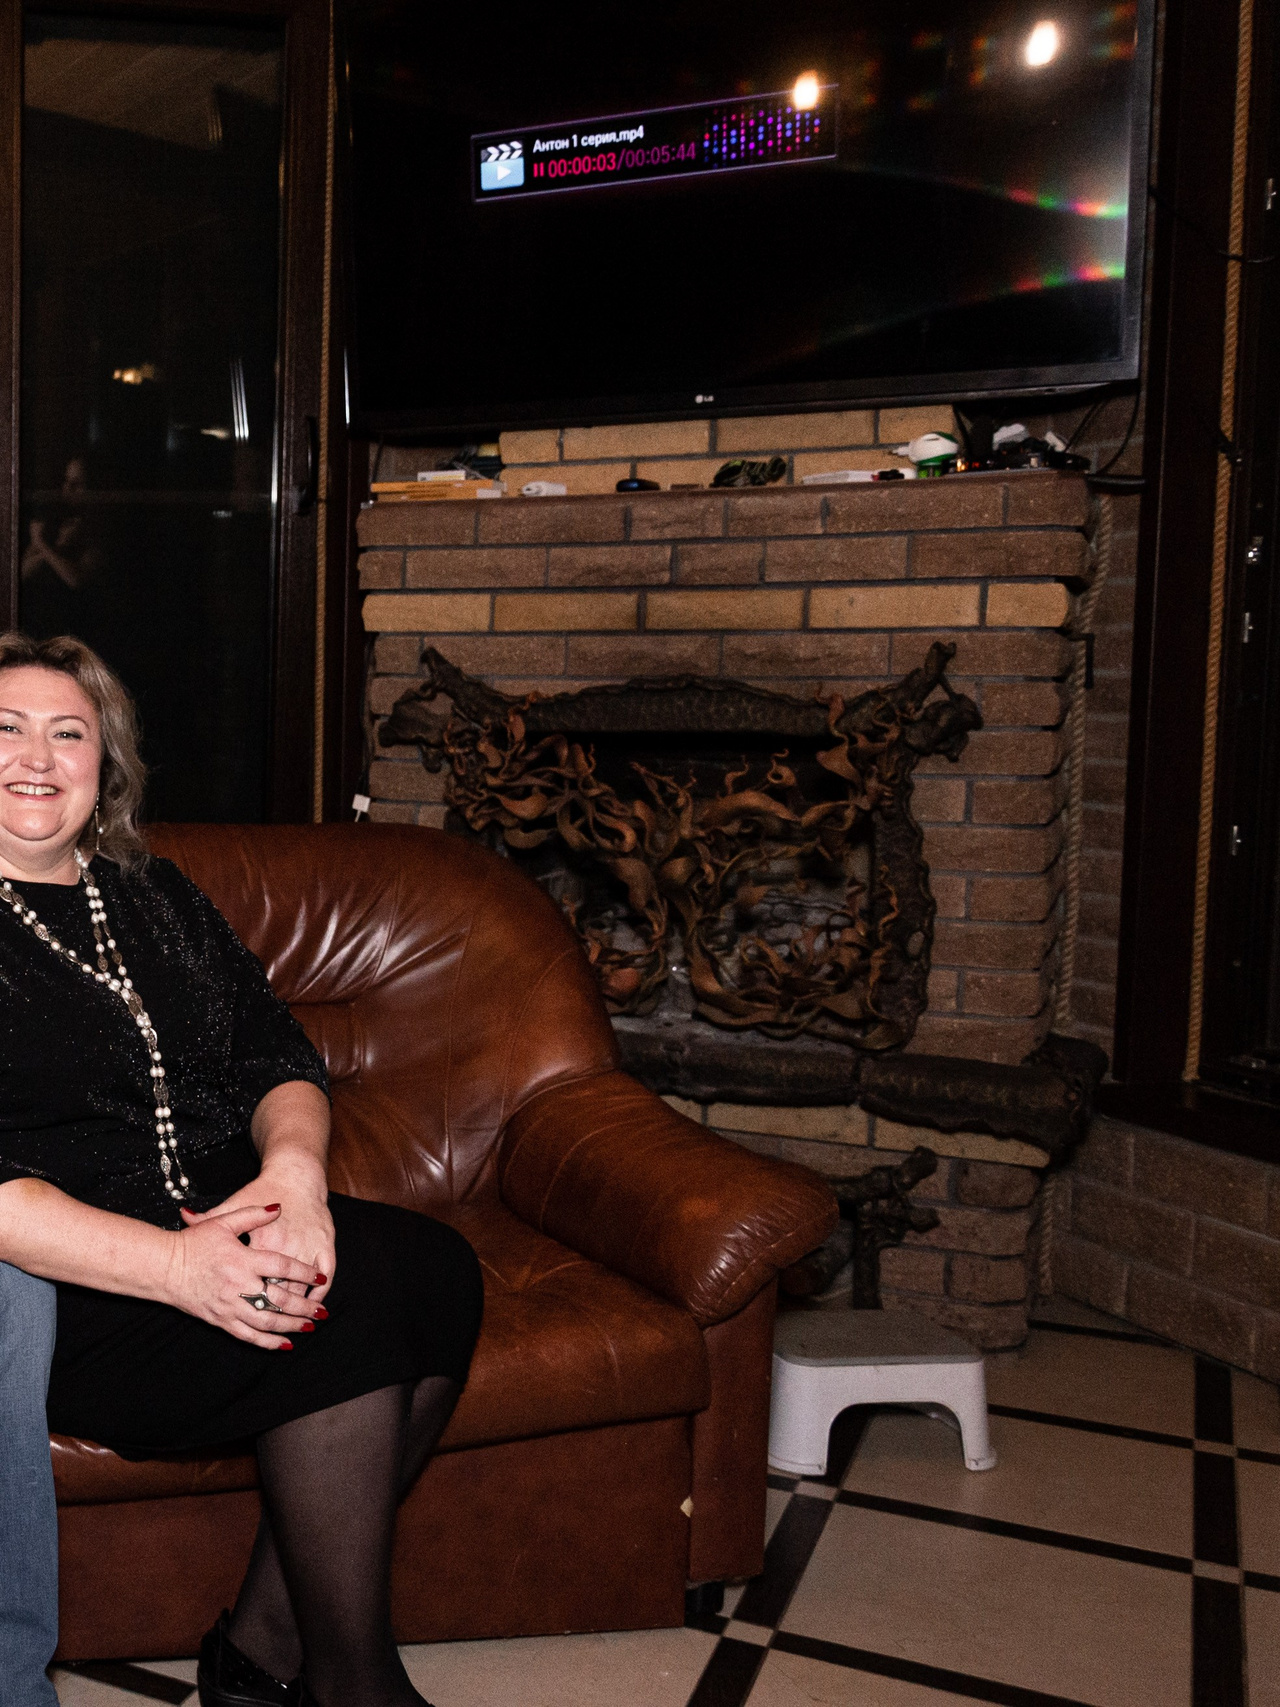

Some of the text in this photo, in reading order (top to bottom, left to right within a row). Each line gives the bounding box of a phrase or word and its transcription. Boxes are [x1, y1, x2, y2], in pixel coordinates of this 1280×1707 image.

[532, 125, 645, 153] Антон 1 серия.mp4
